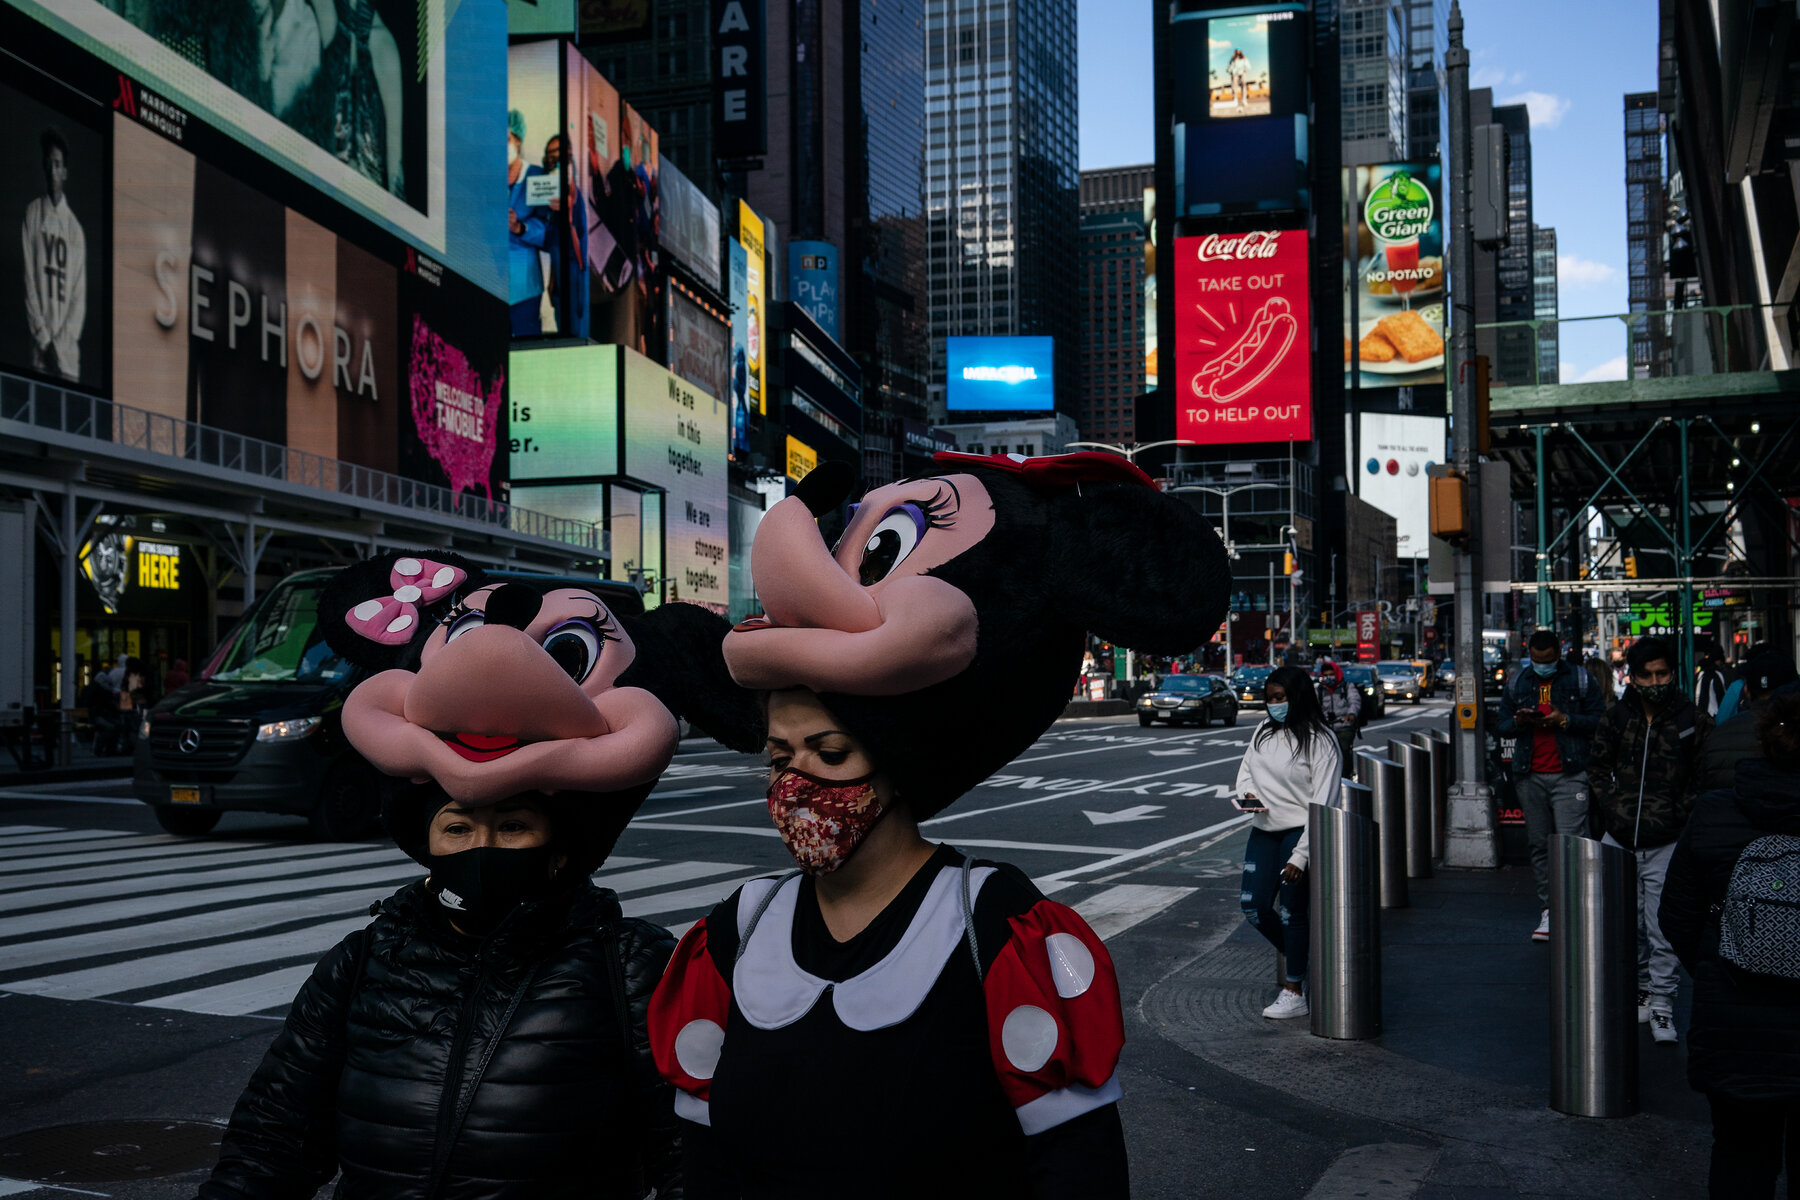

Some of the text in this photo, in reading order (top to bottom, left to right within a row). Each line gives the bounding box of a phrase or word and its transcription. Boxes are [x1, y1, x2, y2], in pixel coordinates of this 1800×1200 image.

[140, 89, 187, 127] MARRIOTT
[140, 106, 183, 141] MARQUIS
[1373, 206, 1429, 224] Green
[1380, 221, 1431, 239] Giant
[1197, 230, 1282, 262] Coca-Cola
[1197, 273, 1285, 292] TAKE OUT
[1366, 267, 1434, 283] NO POTATO
[797, 280, 835, 302] PLAY
[154, 250, 378, 402] SEPHORA
[963, 366, 1037, 382] IMPACUL
[435, 380, 484, 417] WELCOME TO
[668, 377, 694, 410] We are
[435, 401, 484, 443] T-MOBILE
[512, 401, 531, 422] is
[1186, 404, 1301, 423] TO HELP OUT
[677, 413, 701, 445] in this
[668, 445, 703, 476] together.
[685, 501, 710, 528] We are
[695, 538, 724, 566] stronger
[138, 552, 180, 590] HERE
[686, 566, 719, 593] together.
[1362, 613, 1376, 640] tkts
[975, 774, 1104, 792] ONL
[1098, 781, 1239, 800] NLY
[441, 887, 464, 906] NIKE
